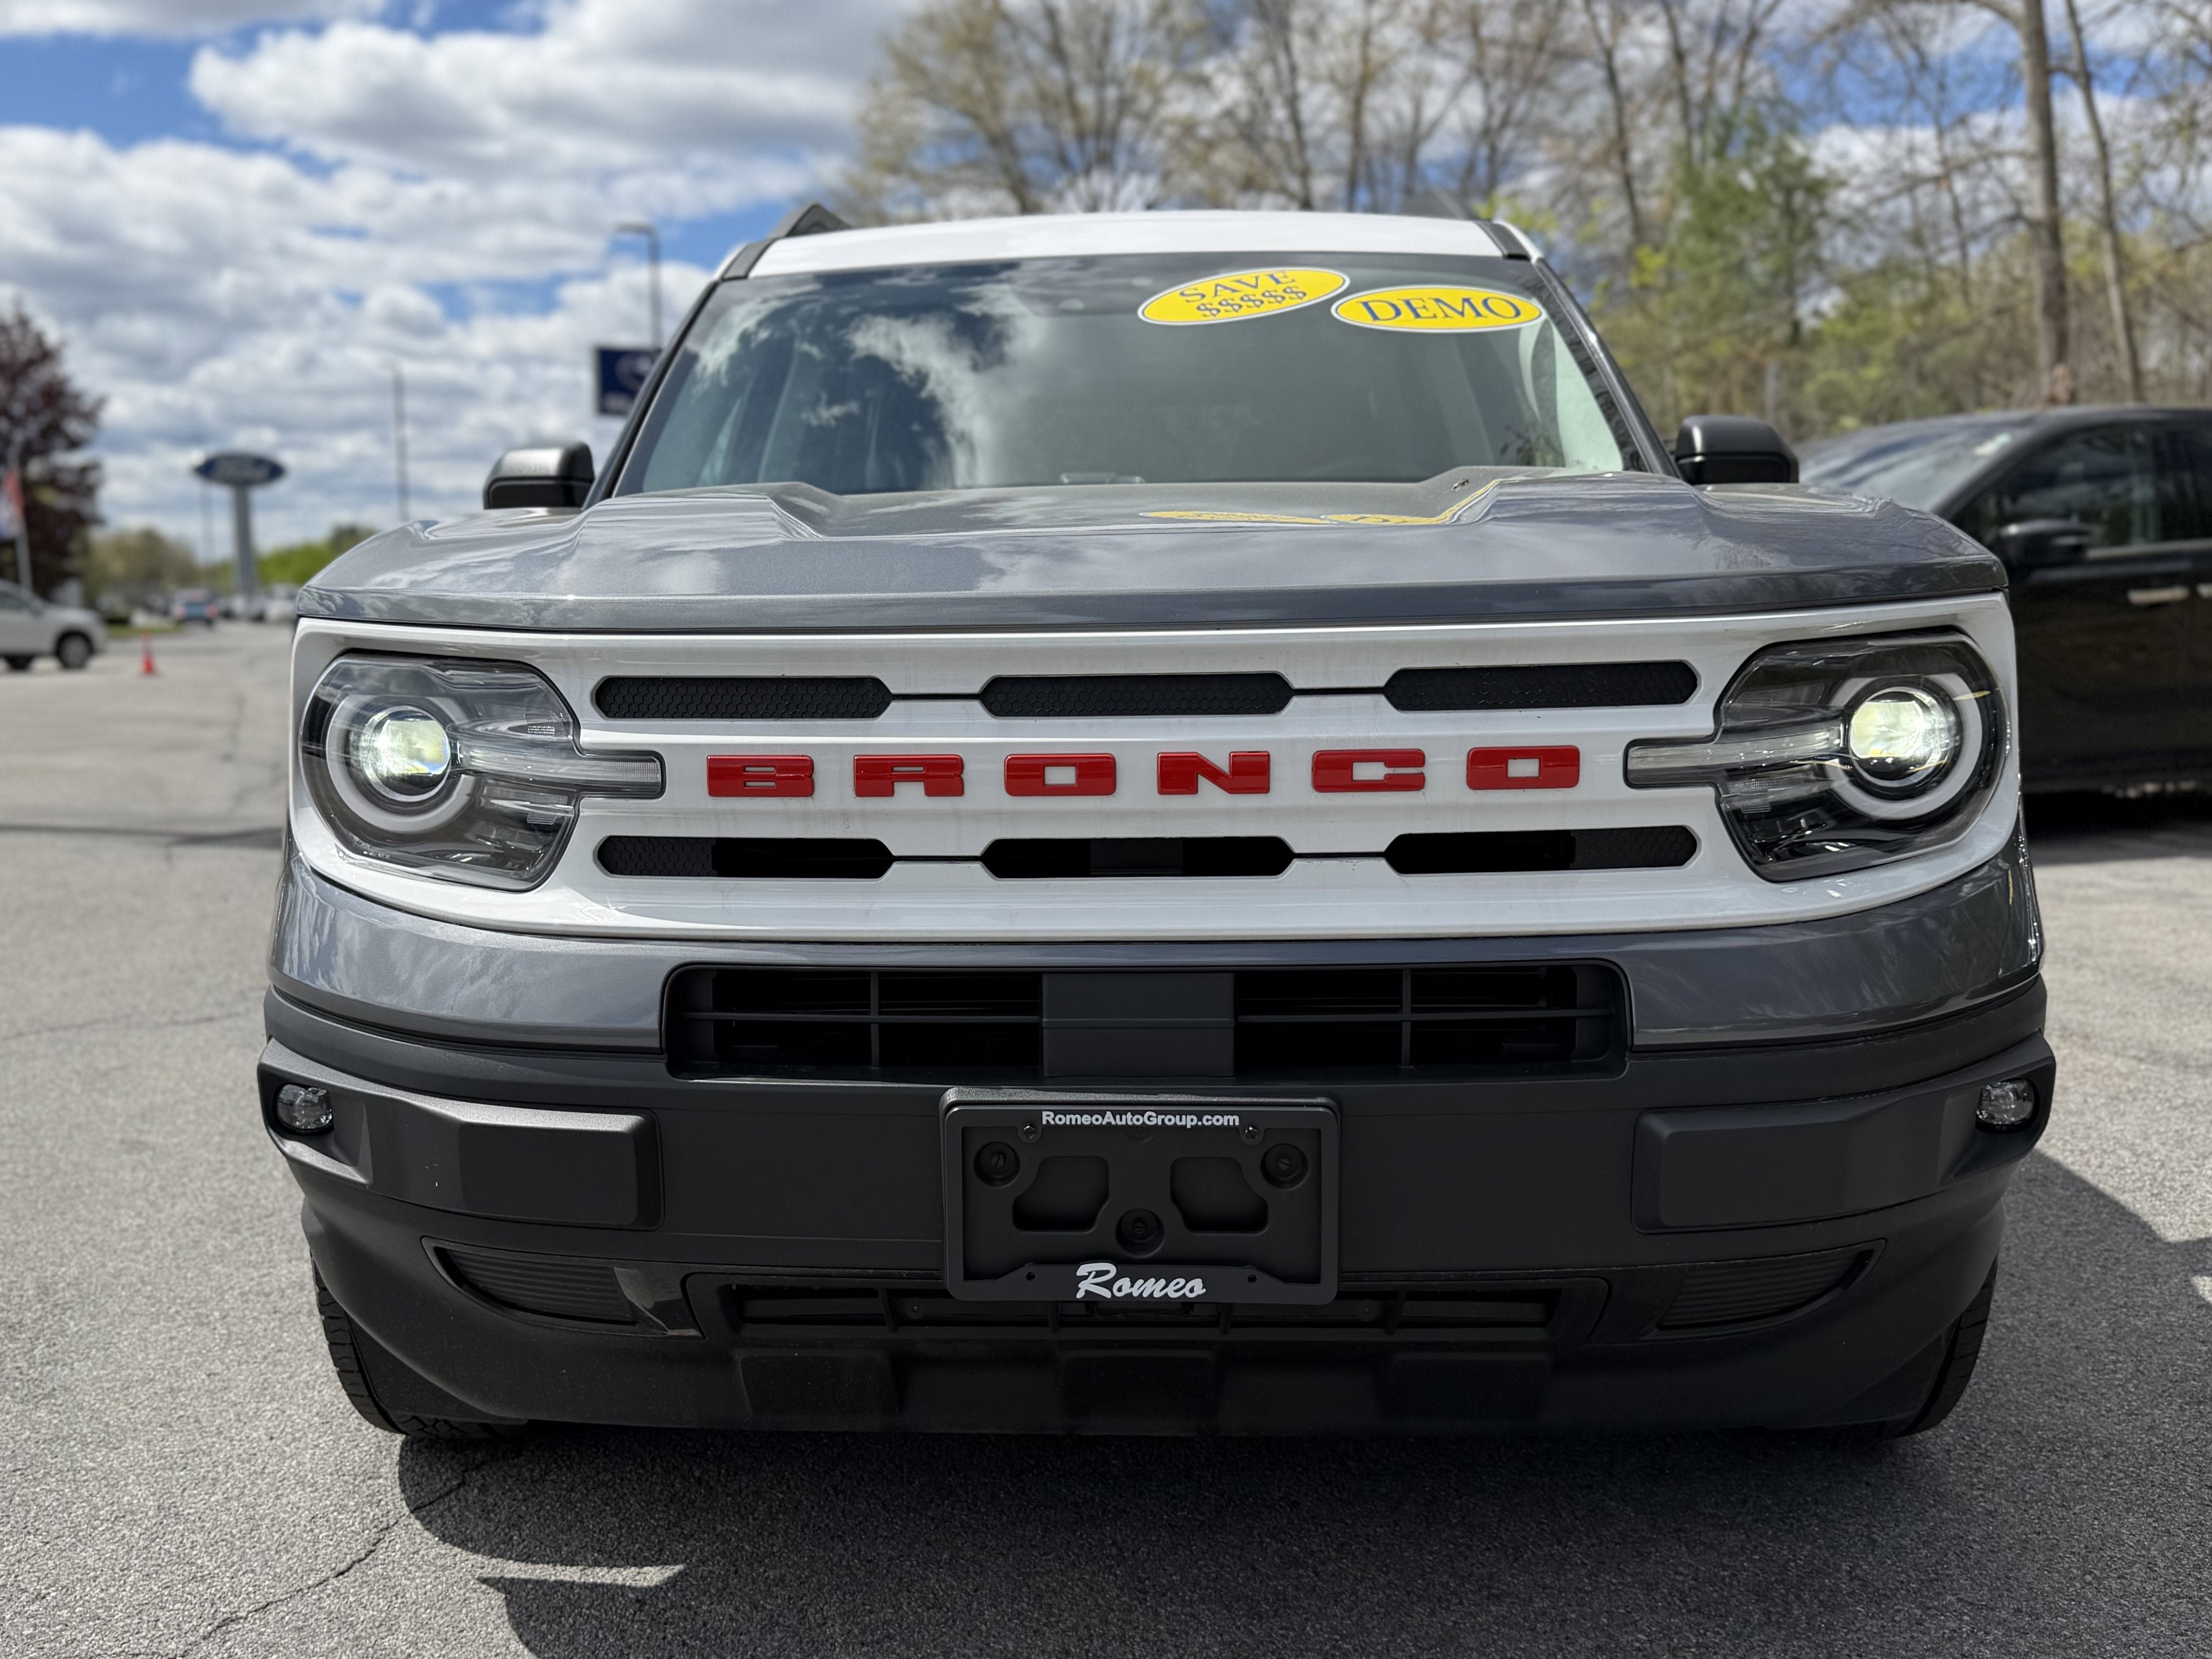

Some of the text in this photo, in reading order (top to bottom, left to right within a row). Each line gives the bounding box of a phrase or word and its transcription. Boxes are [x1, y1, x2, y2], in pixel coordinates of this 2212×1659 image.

[1179, 271, 1296, 303] SAVE
[1196, 286, 1307, 318] $$$$$
[1356, 296, 1522, 322] DEMO
[706, 745, 1581, 798] BRONCO
[1041, 1110, 1240, 1128] RomeoAutoGroup.com
[1076, 1262, 1207, 1299] Romeo
